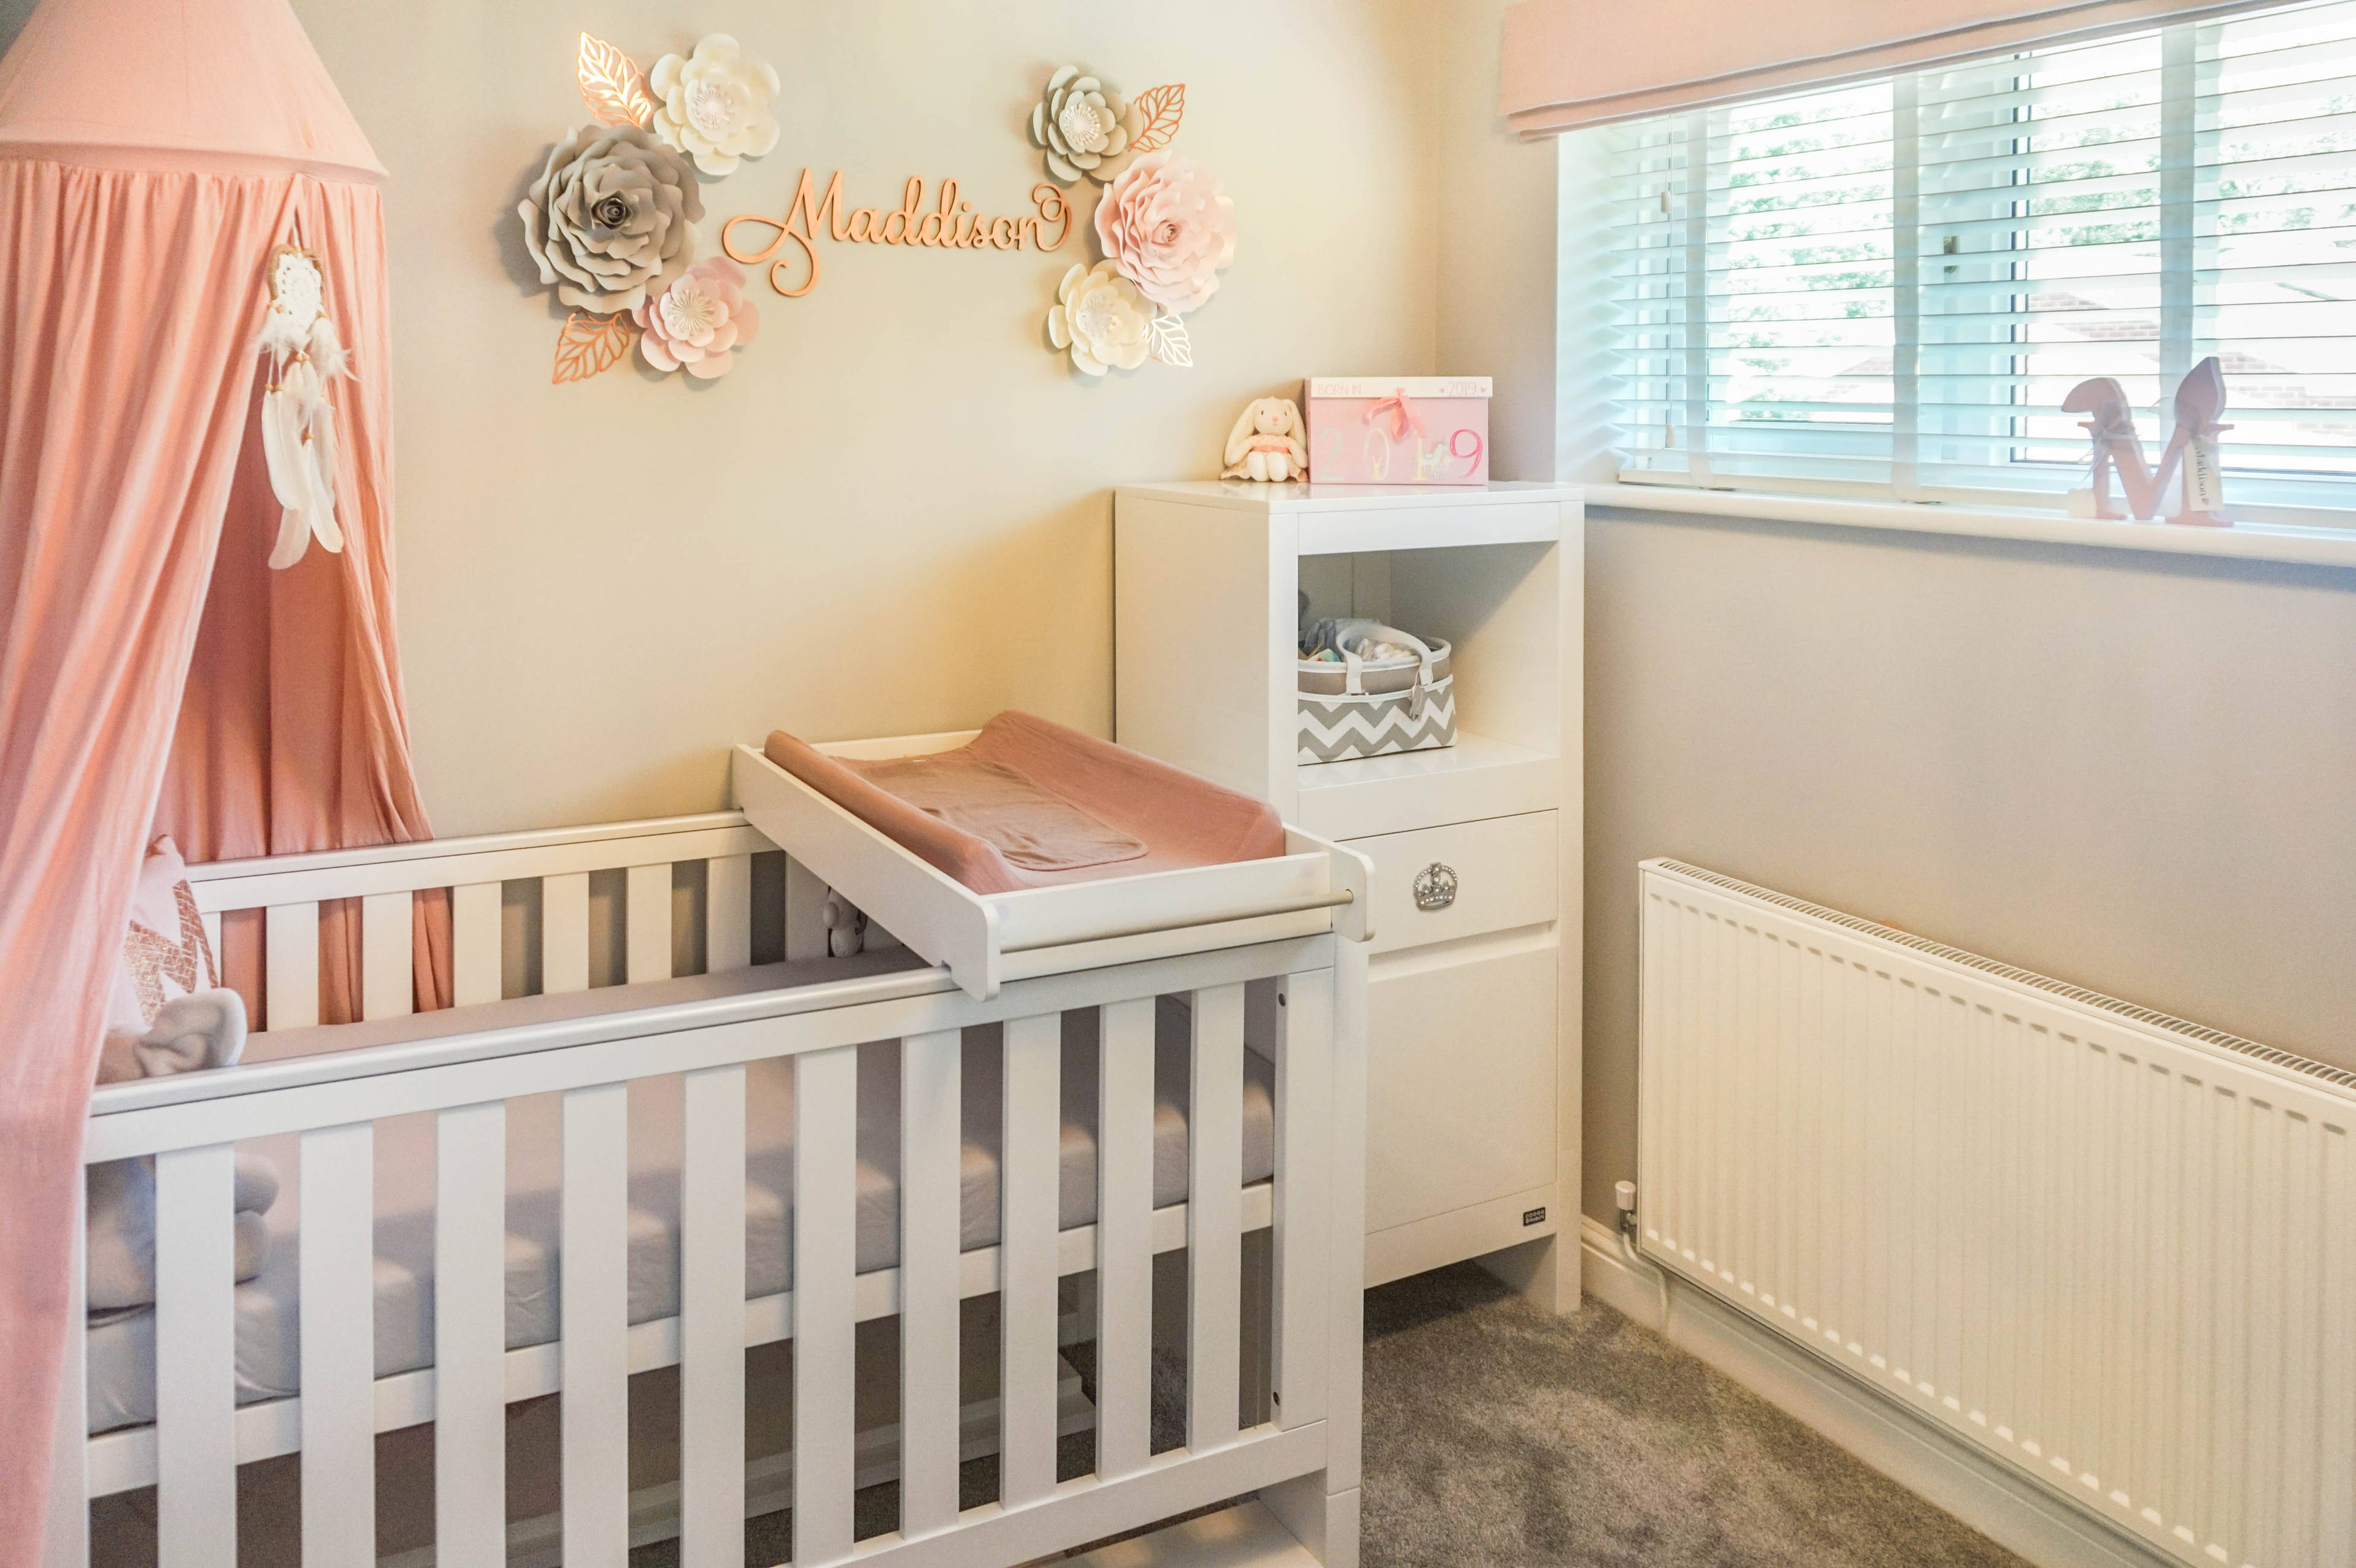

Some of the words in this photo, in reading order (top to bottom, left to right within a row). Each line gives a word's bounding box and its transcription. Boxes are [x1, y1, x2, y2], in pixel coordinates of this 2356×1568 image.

[722, 167, 1072, 297] Maddison
[1318, 383, 1348, 395] BORN
[1352, 383, 1361, 394] IN
[1448, 382, 1477, 396] 2019
[2195, 447, 2208, 496] Maddison
